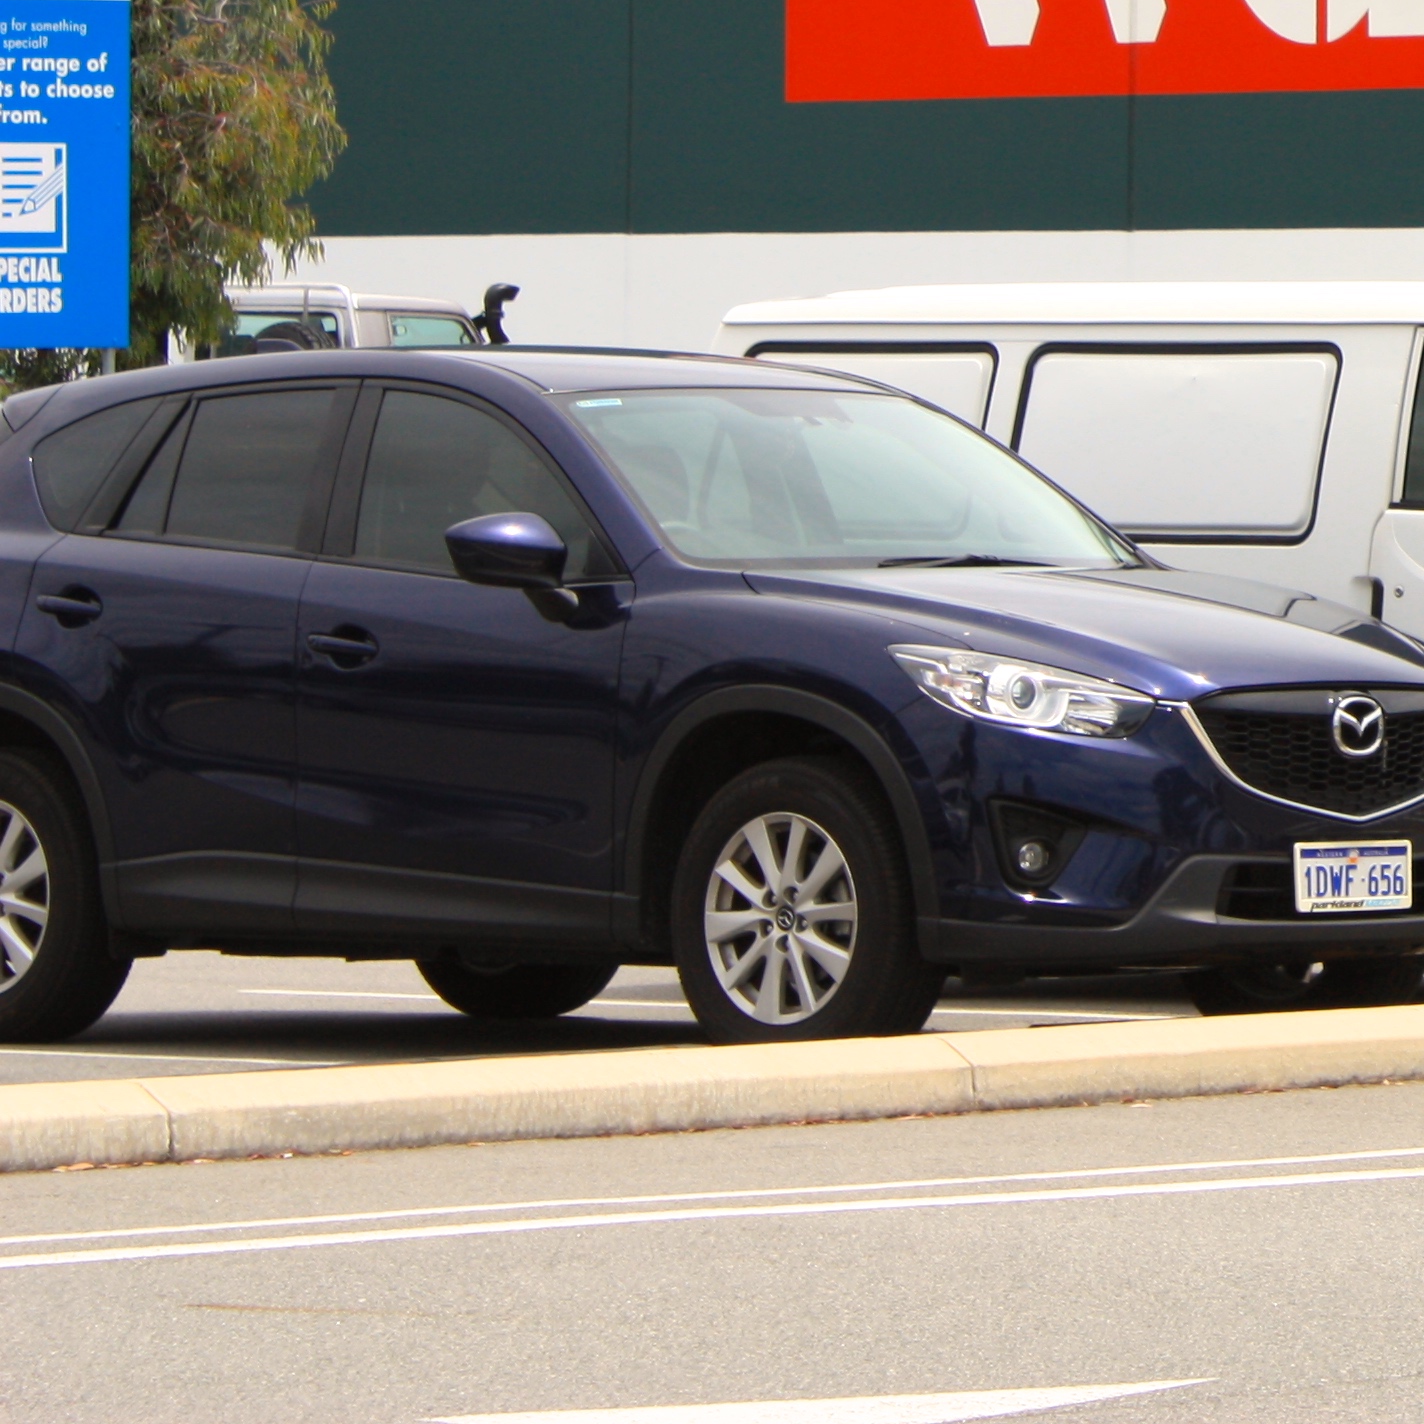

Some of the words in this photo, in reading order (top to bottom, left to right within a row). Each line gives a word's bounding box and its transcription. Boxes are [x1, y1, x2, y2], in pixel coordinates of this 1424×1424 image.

[11, 17, 27, 31] for
[31, 18, 87, 36] something
[3, 35, 49, 52] special?
[22, 57, 81, 77] range
[86, 51, 109, 73] of
[20, 80, 40, 98] to
[46, 77, 115, 99] choose
[0, 256, 63, 283] PECIAL
[0, 287, 63, 314] RDERS
